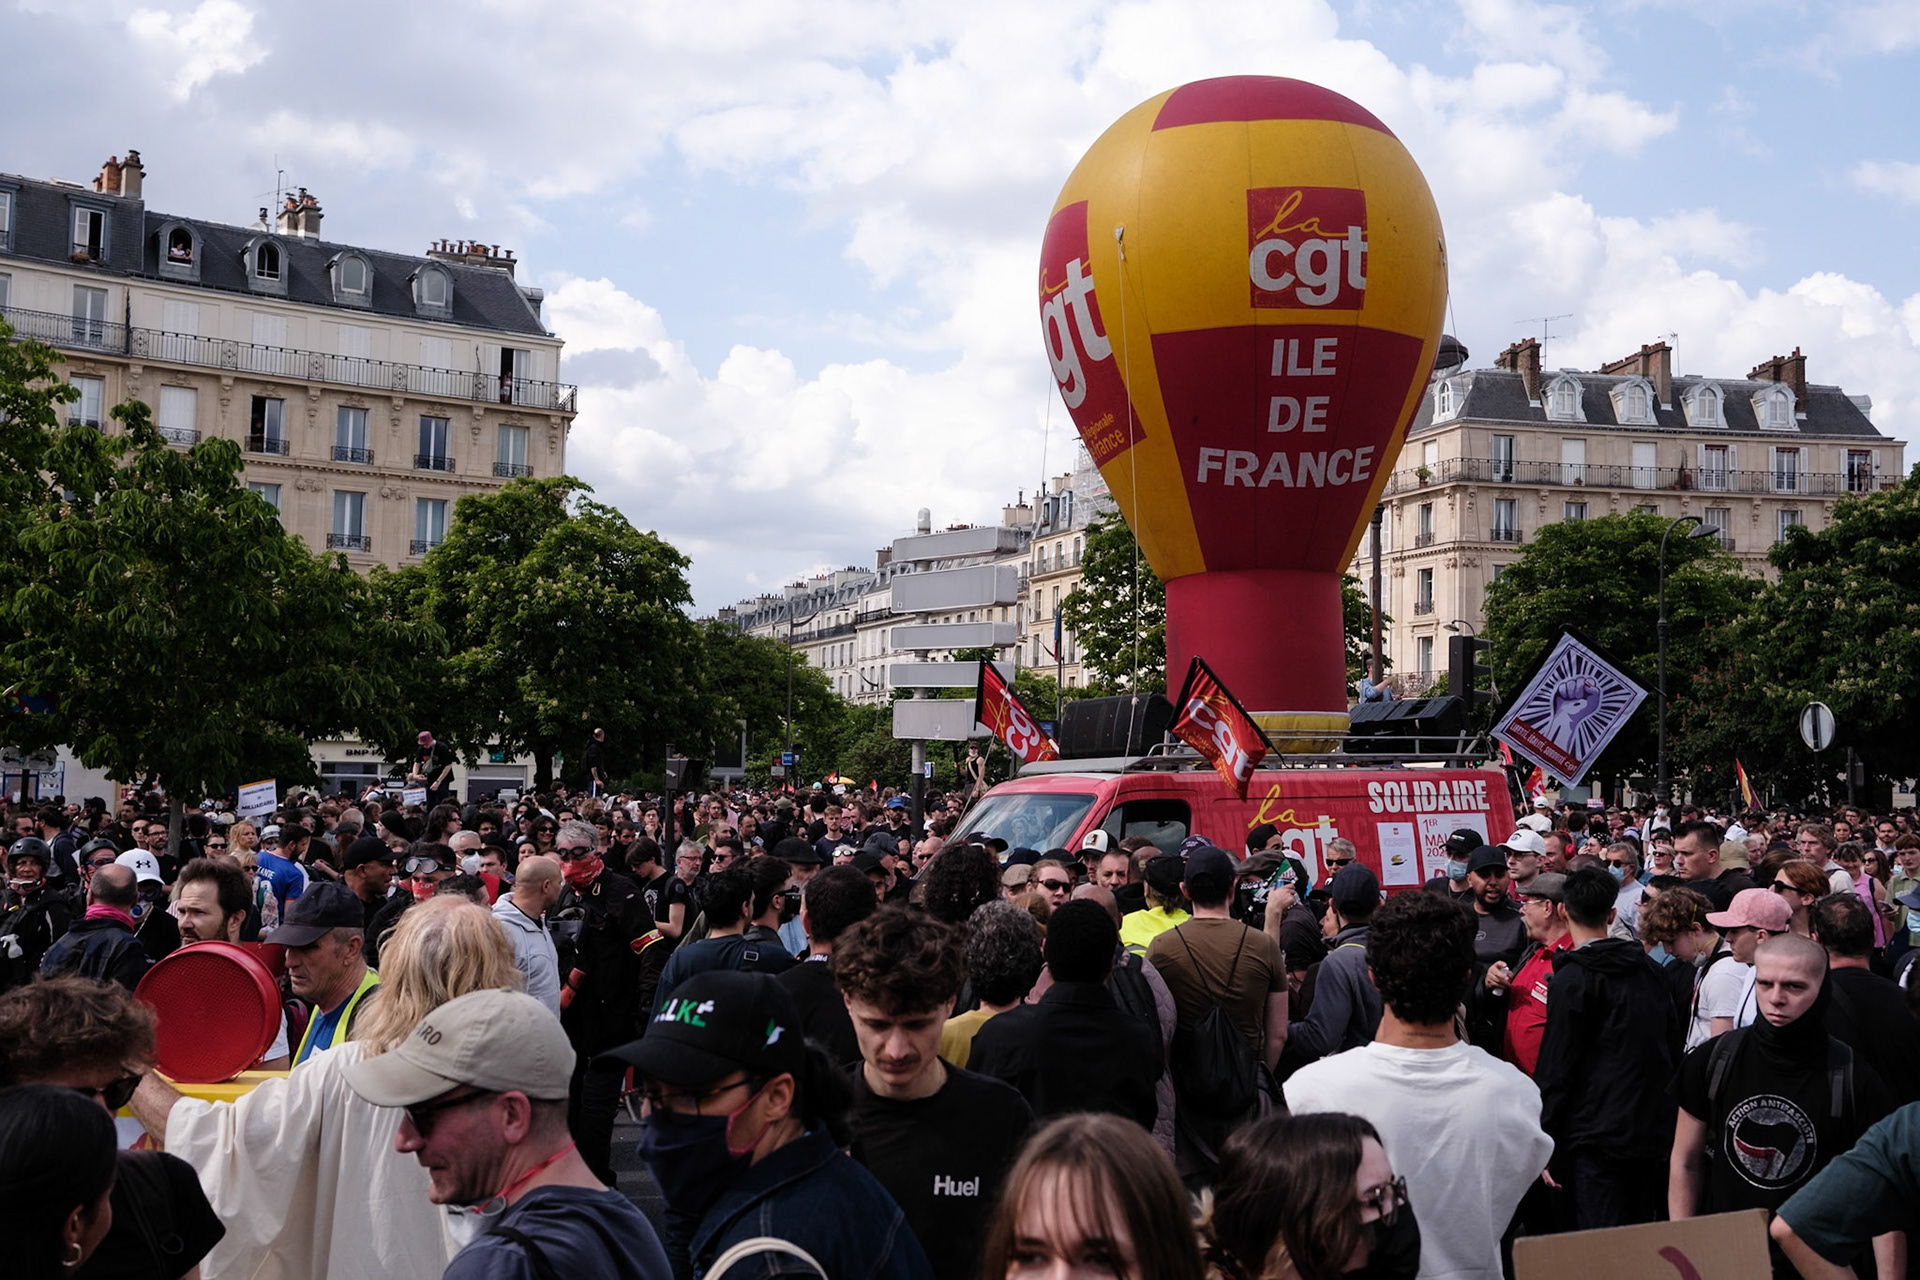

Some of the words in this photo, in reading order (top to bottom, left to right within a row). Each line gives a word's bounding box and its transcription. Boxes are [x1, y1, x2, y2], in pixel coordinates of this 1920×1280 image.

[1249, 225, 1368, 306] cgt
[1042, 257, 1113, 409] gt
[1271, 337, 1338, 376] ILE
[1267, 396, 1330, 433] DE
[1197, 445, 1375, 488] FRANCE
[1247, 784, 1336, 829] la
[1367, 780, 1490, 813] SOLIDAIRE
[1728, 1100, 1758, 1129] ACTION
[933, 1175, 980, 1197] Huel
